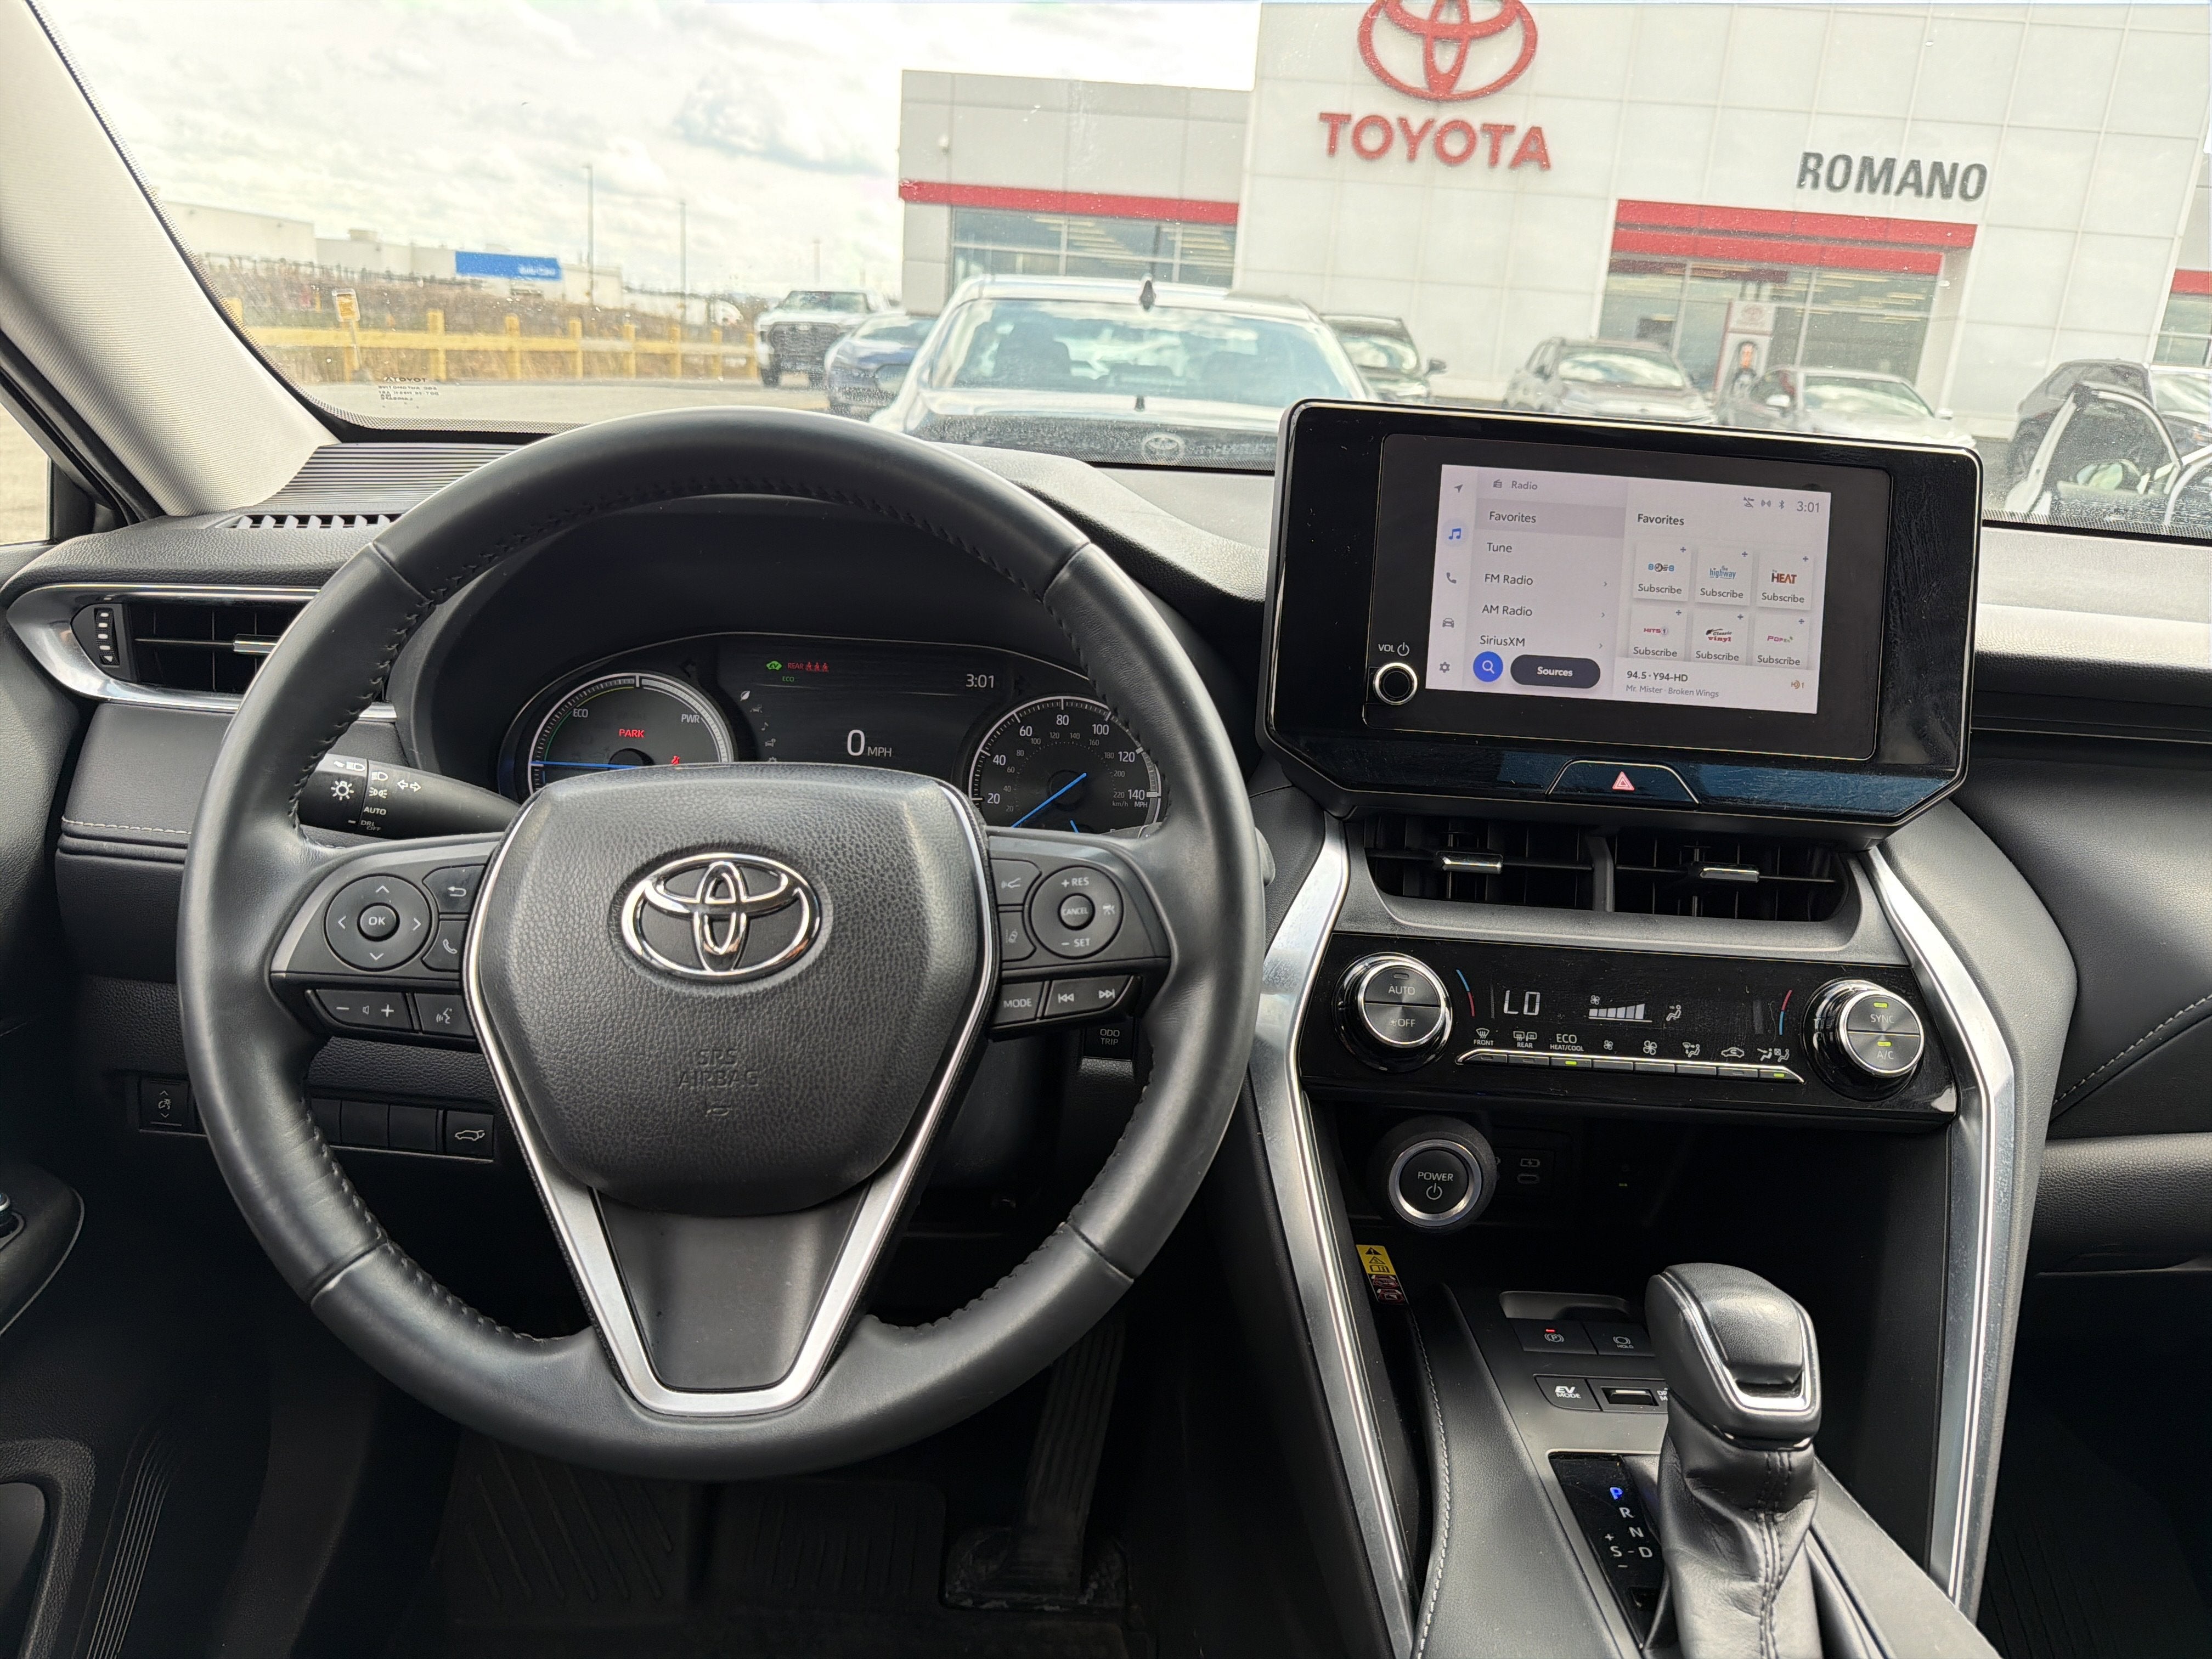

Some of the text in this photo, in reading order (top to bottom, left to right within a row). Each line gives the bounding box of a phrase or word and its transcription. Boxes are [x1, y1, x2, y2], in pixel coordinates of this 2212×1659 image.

[1319, 111, 1551, 171] TOYOTA
[1796, 151, 1988, 202] ROMANO
[1511, 481, 1538, 491] Radio
[1797, 501, 1820, 513] 3:01
[1489, 511, 1536, 524] Favorites
[1637, 514, 1685, 526] Favorites
[1487, 542, 1513, 554] Tune
[1709, 567, 1736, 580] highway
[1771, 572, 1797, 584] HEAT
[1485, 573, 1533, 586] FM Radio
[1638, 583, 1682, 595] Subscribe
[1700, 588, 1744, 599] Subscribe
[1762, 592, 1805, 603] Subscribe
[1482, 605, 1533, 617] AM Radio
[1480, 635, 1525, 647] SiriusXM
[1378, 644, 1395, 652] VOL
[1633, 646, 1678, 658] Subscribe
[1695, 651, 1740, 662] Subscribe
[1757, 655, 1801, 667] Subscribe
[1537, 666, 1573, 678] Sources
[1627, 671, 1688, 682] 94.5 Y94-HD
[966, 674, 995, 689] 3:01
[1639, 686, 1663, 695] Mister
[1668, 687, 1694, 696] Broken
[1696, 690, 1719, 699] Wings
[573, 708, 589, 718] ECO
[681, 714, 701, 724] PWR
[1056, 714, 1069, 726] 80
[618, 729, 645, 738] PARK
[1019, 726, 1033, 737] 60
[1092, 724, 1109, 736] 100
[847, 729, 892, 757] 0 MPH
[992, 755, 1006, 766] 40
[1118, 751, 1135, 763] 120
[987, 793, 1001, 804] 20
[1127, 789, 1146, 800] 140
[363, 806, 387, 816] AUTO
[1071, 877, 1090, 887] RES
[1062, 907, 1089, 916] CANCEL
[368, 916, 386, 926] OK
[1074, 938, 1091, 947] SET
[1388, 985, 1415, 996] AUTO
[1003, 998, 1032, 1008] MODE
[1503, 990, 1541, 1016] LO
[1397, 1018, 1416, 1028] OFF
[1870, 1014, 1894, 1024] SYNC
[1100, 1029, 1120, 1037] ODO
[1556, 1033, 1577, 1044] ECO
[1550, 1043, 1584, 1052] HEAT/COOL
[698, 1048, 737, 1066] SRS
[1877, 1050, 1894, 1059] A/C
[678, 1070, 759, 1088] AIRBAG
[1417, 1171, 1454, 1182] POWER
[1610, 1487, 1623, 1500] P
[1619, 1507, 1634, 1519] R
[1628, 1527, 1644, 1538] N
[1610, 1545, 1653, 1558] S D
